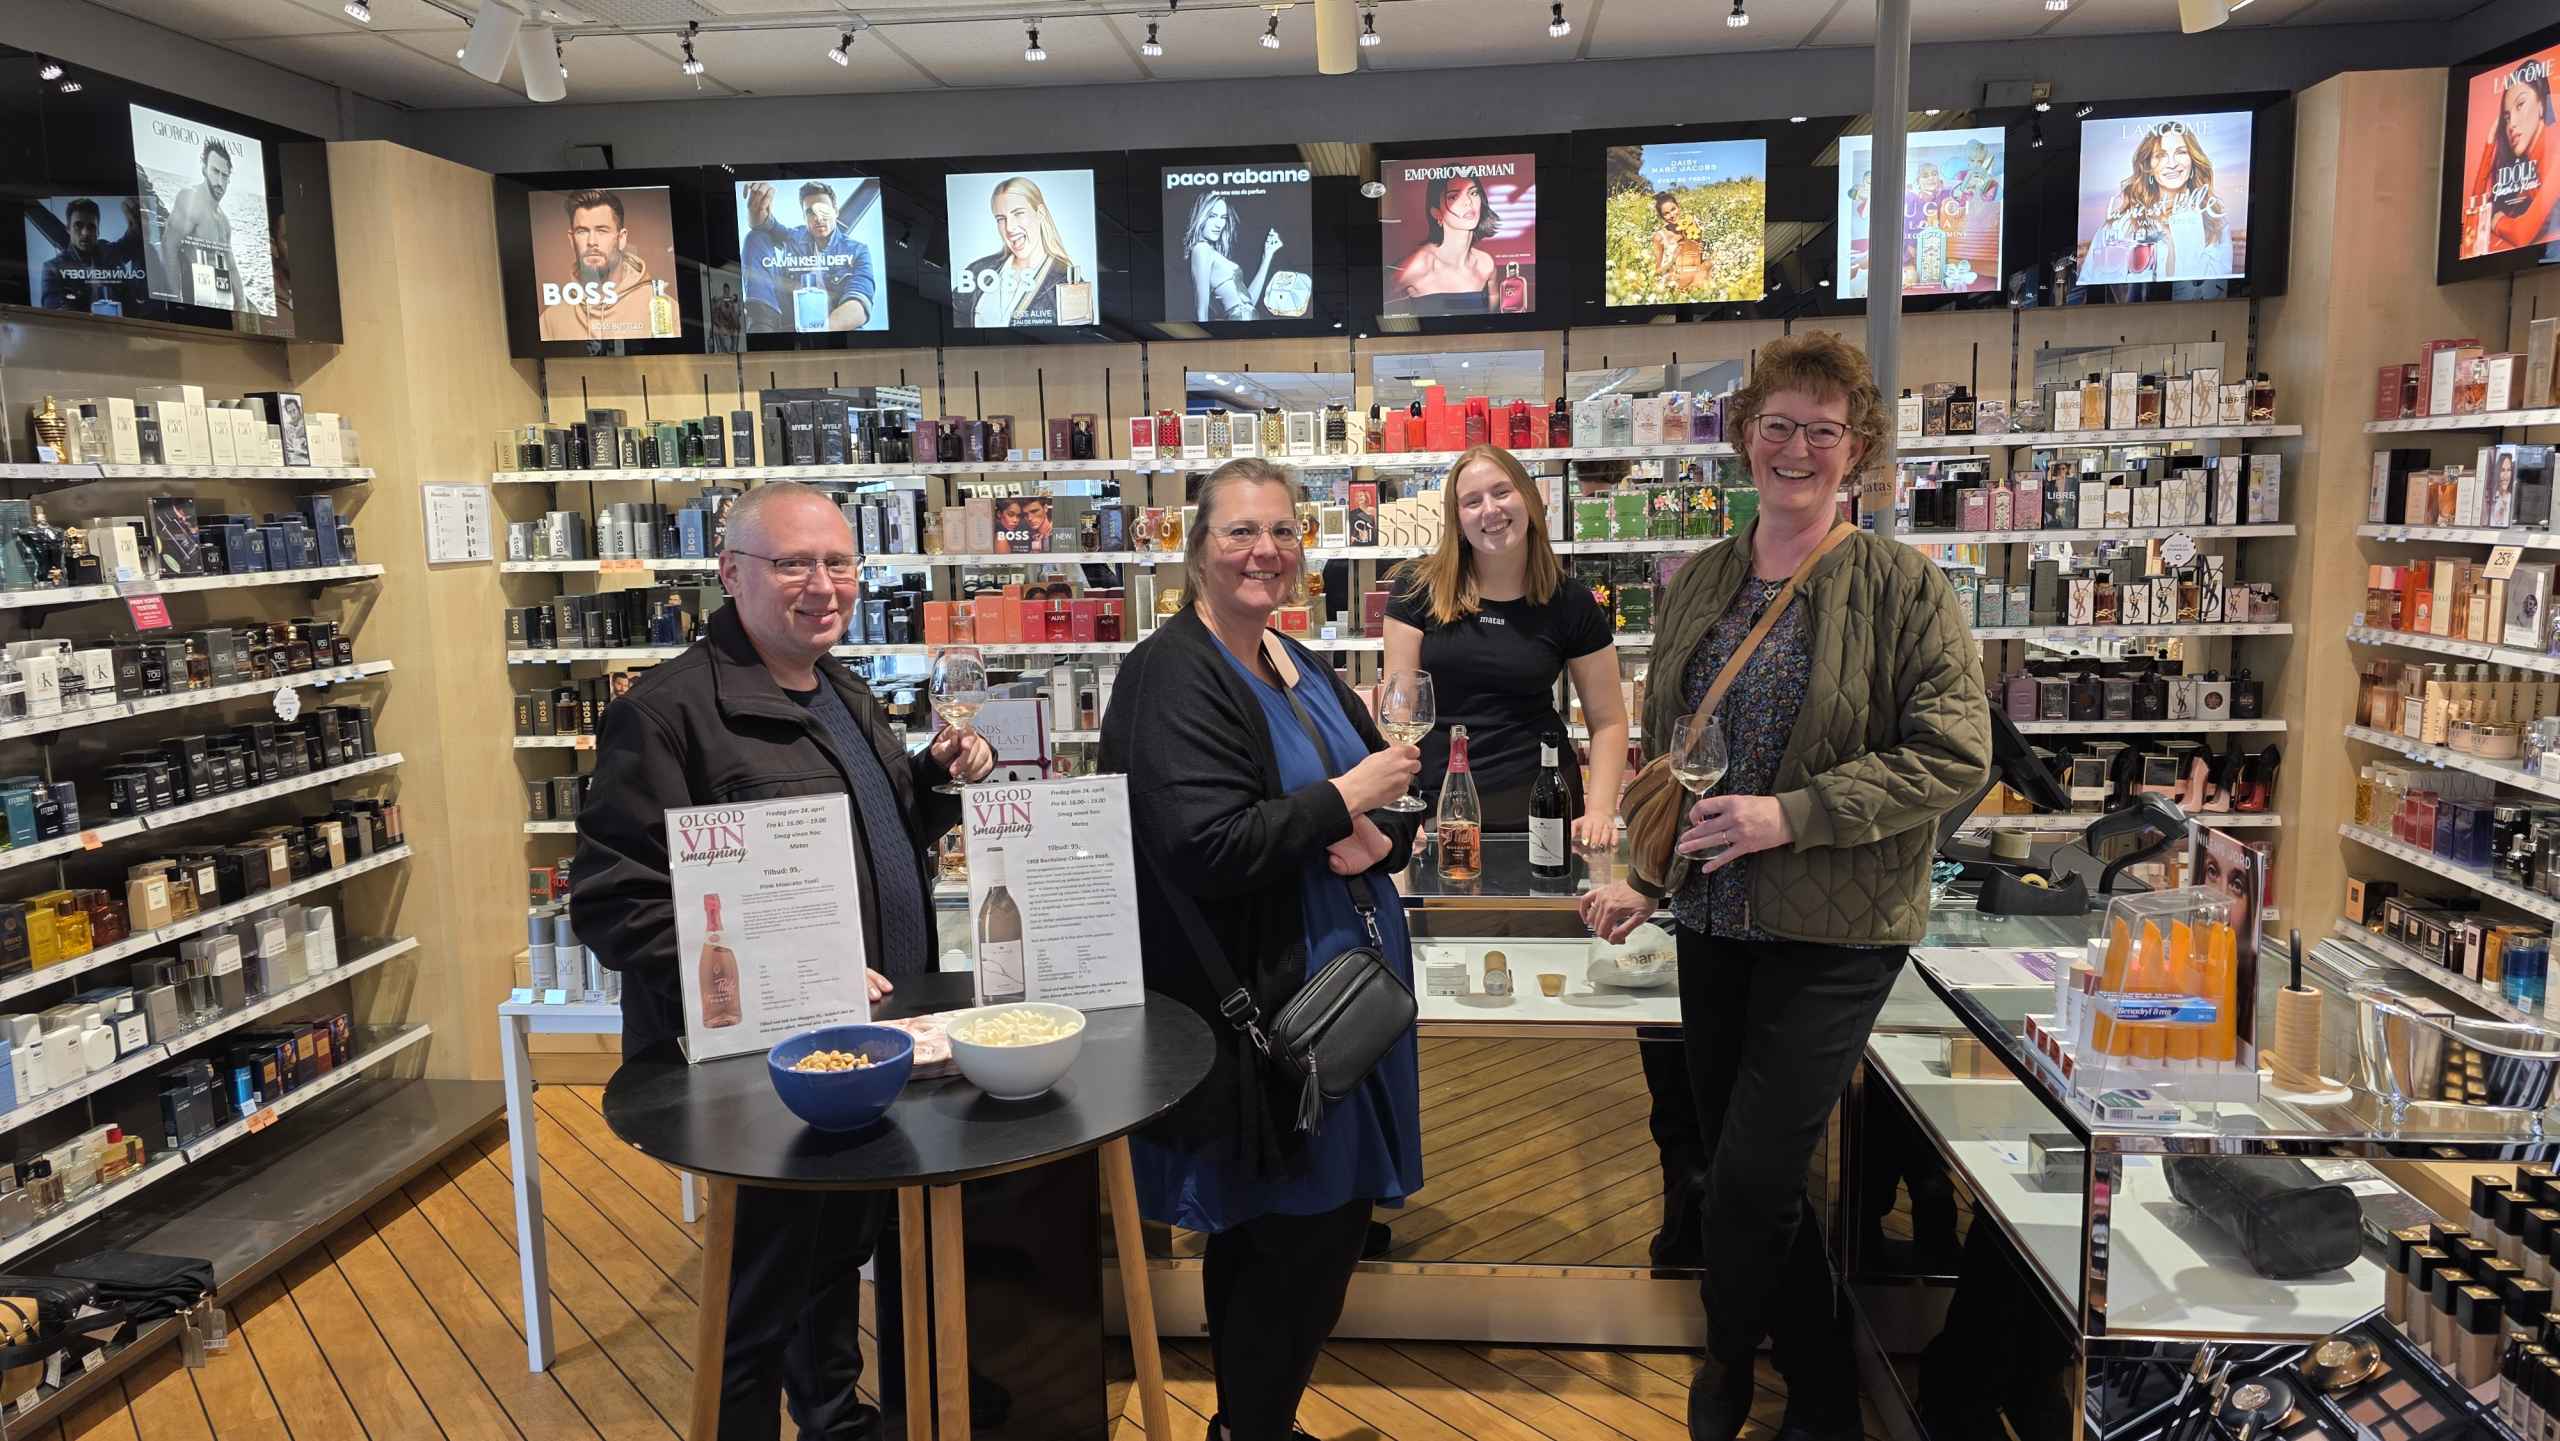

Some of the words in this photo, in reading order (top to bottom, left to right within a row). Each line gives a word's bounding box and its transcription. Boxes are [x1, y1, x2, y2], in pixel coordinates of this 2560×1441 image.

[152, 119, 199, 146] GIORGIO
[203, 134, 245, 158] ARMANI
[1404, 167, 1456, 181] EMPORIO
[1469, 163, 1515, 178] ARMANI
[1652, 166, 1677, 174] MARC
[1679, 164, 1717, 172] JACOBS
[1671, 159, 1697, 167] DAISY
[2498, 157, 2538, 185] IDÔLE
[1166, 172, 1219, 189] paco
[1223, 168, 1310, 185] rabanne
[1904, 200, 1969, 218] UCCI
[1908, 219, 1952, 230] LORA
[762, 254, 797, 268] CALVIN
[799, 254, 826, 267] KLEIN
[827, 254, 854, 266] DEFY
[955, 268, 1036, 293] BOSS
[542, 281, 619, 306] BOSS
[1030, 309, 1052, 318] ALIVE
[625, 442, 633, 463] BOSS
[664, 441, 672, 462] BOSS
[2047, 491, 2075, 500] LIBRE
[687, 527, 695, 551] BOSS
[996, 531, 1029, 541] BOSS
[1055, 532, 1072, 541] NEW
[564, 605, 572, 629] BOSS
[1050, 614, 1065, 623] ALIVE
[1479, 616, 1505, 626] matas
[146, 669, 161, 679] YOU
[583, 700, 591, 724] BOSS
[972, 788, 1032, 803] ØLGOD
[678, 809, 745, 829] ØLGOD
[972, 801, 1033, 827] VIN
[678, 823, 746, 852] VIN
[972, 822, 1033, 841] Smagning
[680, 846, 747, 868] Smagning
[2117, 1007, 2153, 1017] Benadryl
